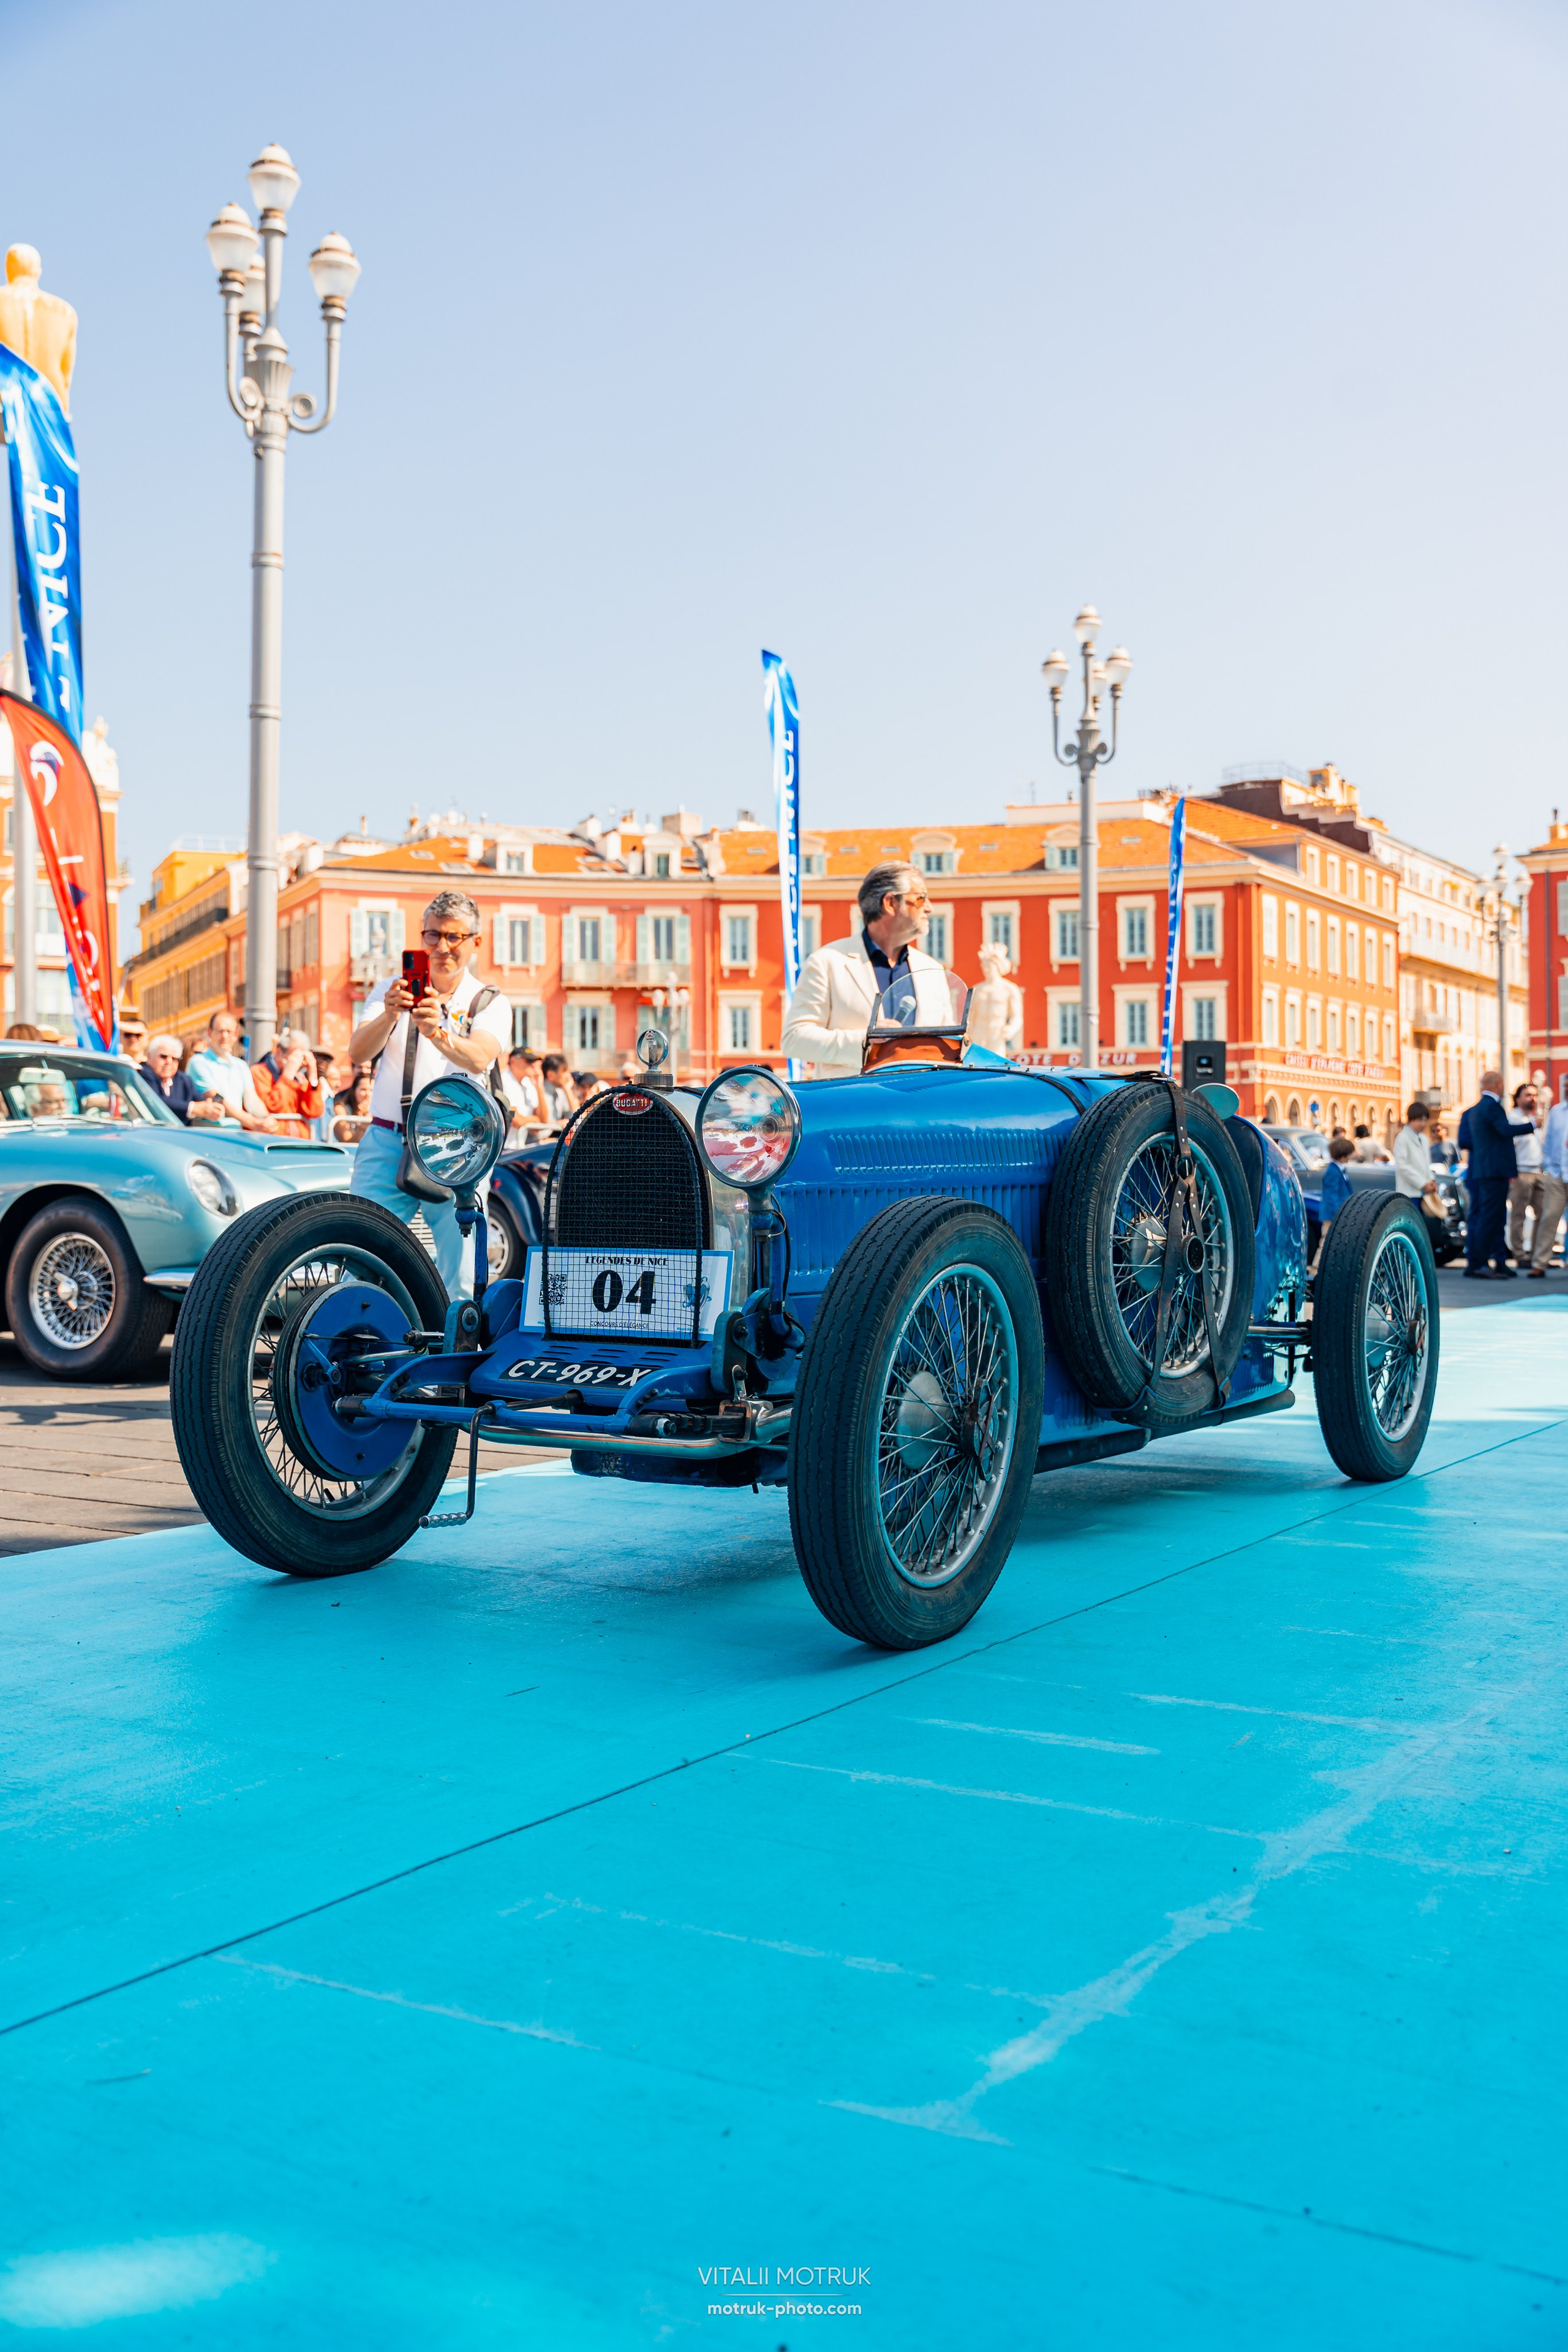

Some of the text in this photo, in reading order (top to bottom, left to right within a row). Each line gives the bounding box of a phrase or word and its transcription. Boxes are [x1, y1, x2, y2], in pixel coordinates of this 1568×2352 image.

[616, 1099, 647, 1107] BUGATTI
[586, 1256, 669, 1266] LEGENDES DE NICE
[592, 1270, 657, 1314] 04
[508, 1360, 651, 1387] CT-969-X
